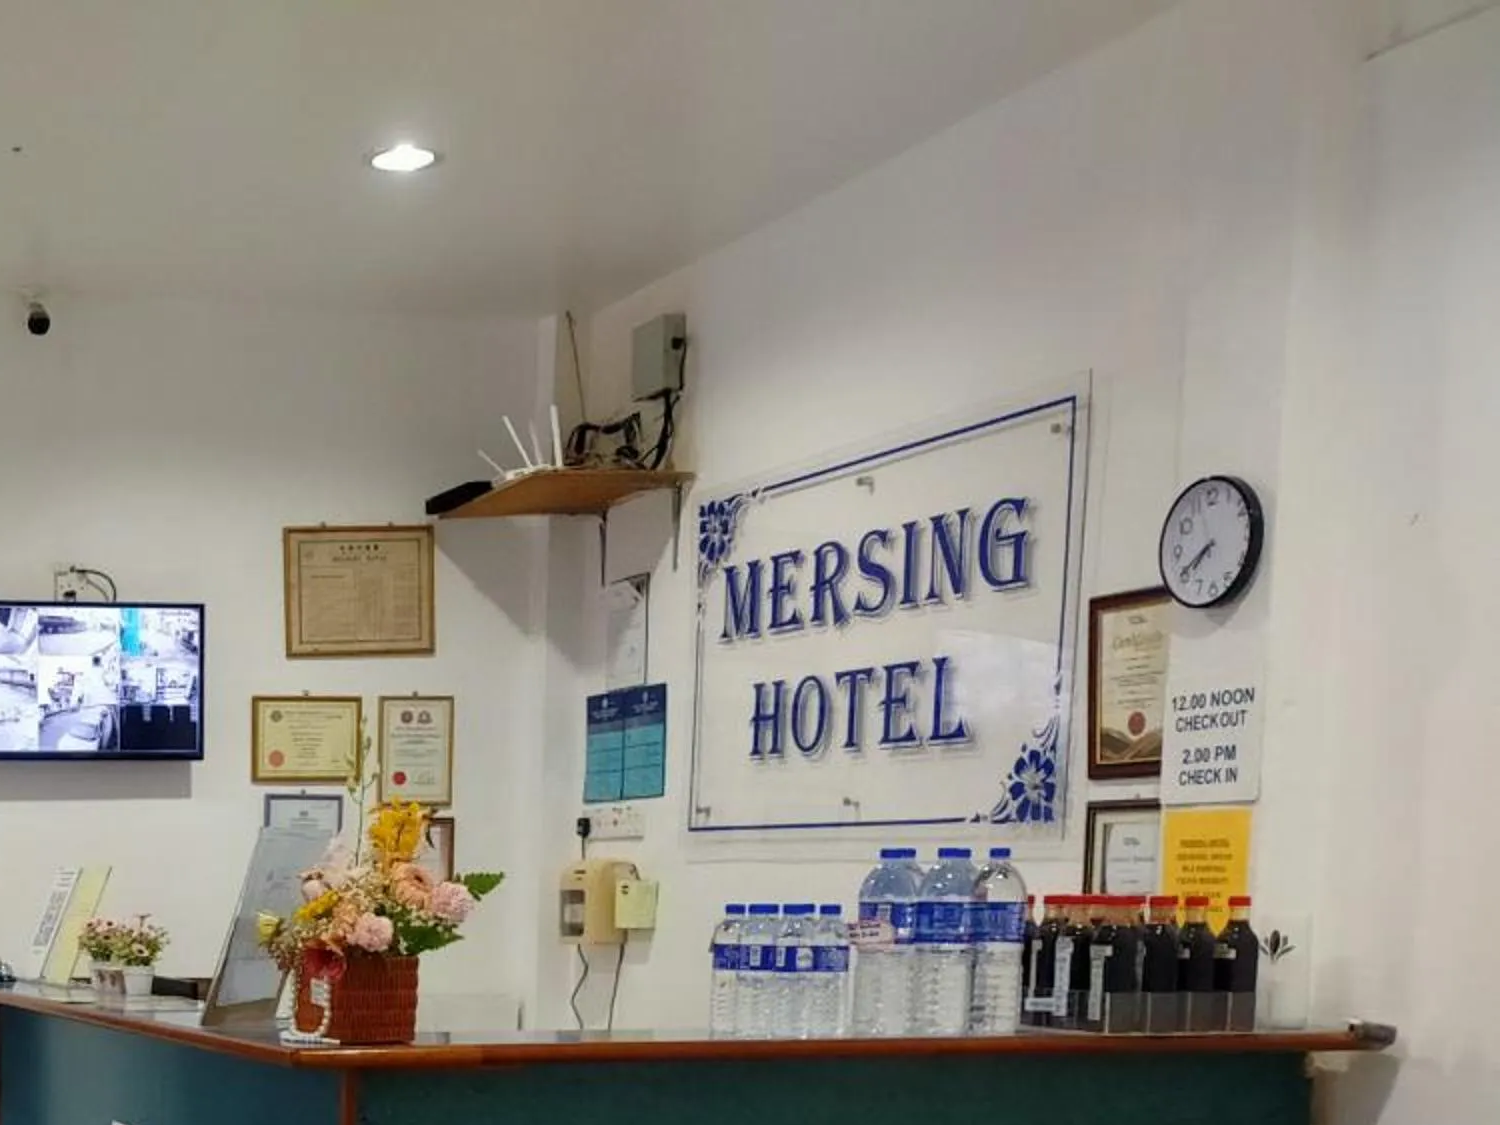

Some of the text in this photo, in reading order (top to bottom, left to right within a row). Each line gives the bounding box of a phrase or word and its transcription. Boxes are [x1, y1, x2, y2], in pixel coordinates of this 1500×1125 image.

[719, 497, 1030, 642] MERSING
[750, 656, 968, 760] HOTEL
[1172, 687, 1255, 712] 12.00 NOON
[1182, 744, 1236, 765] 2.00 PM
[1179, 767, 1238, 786] CHECK IN
